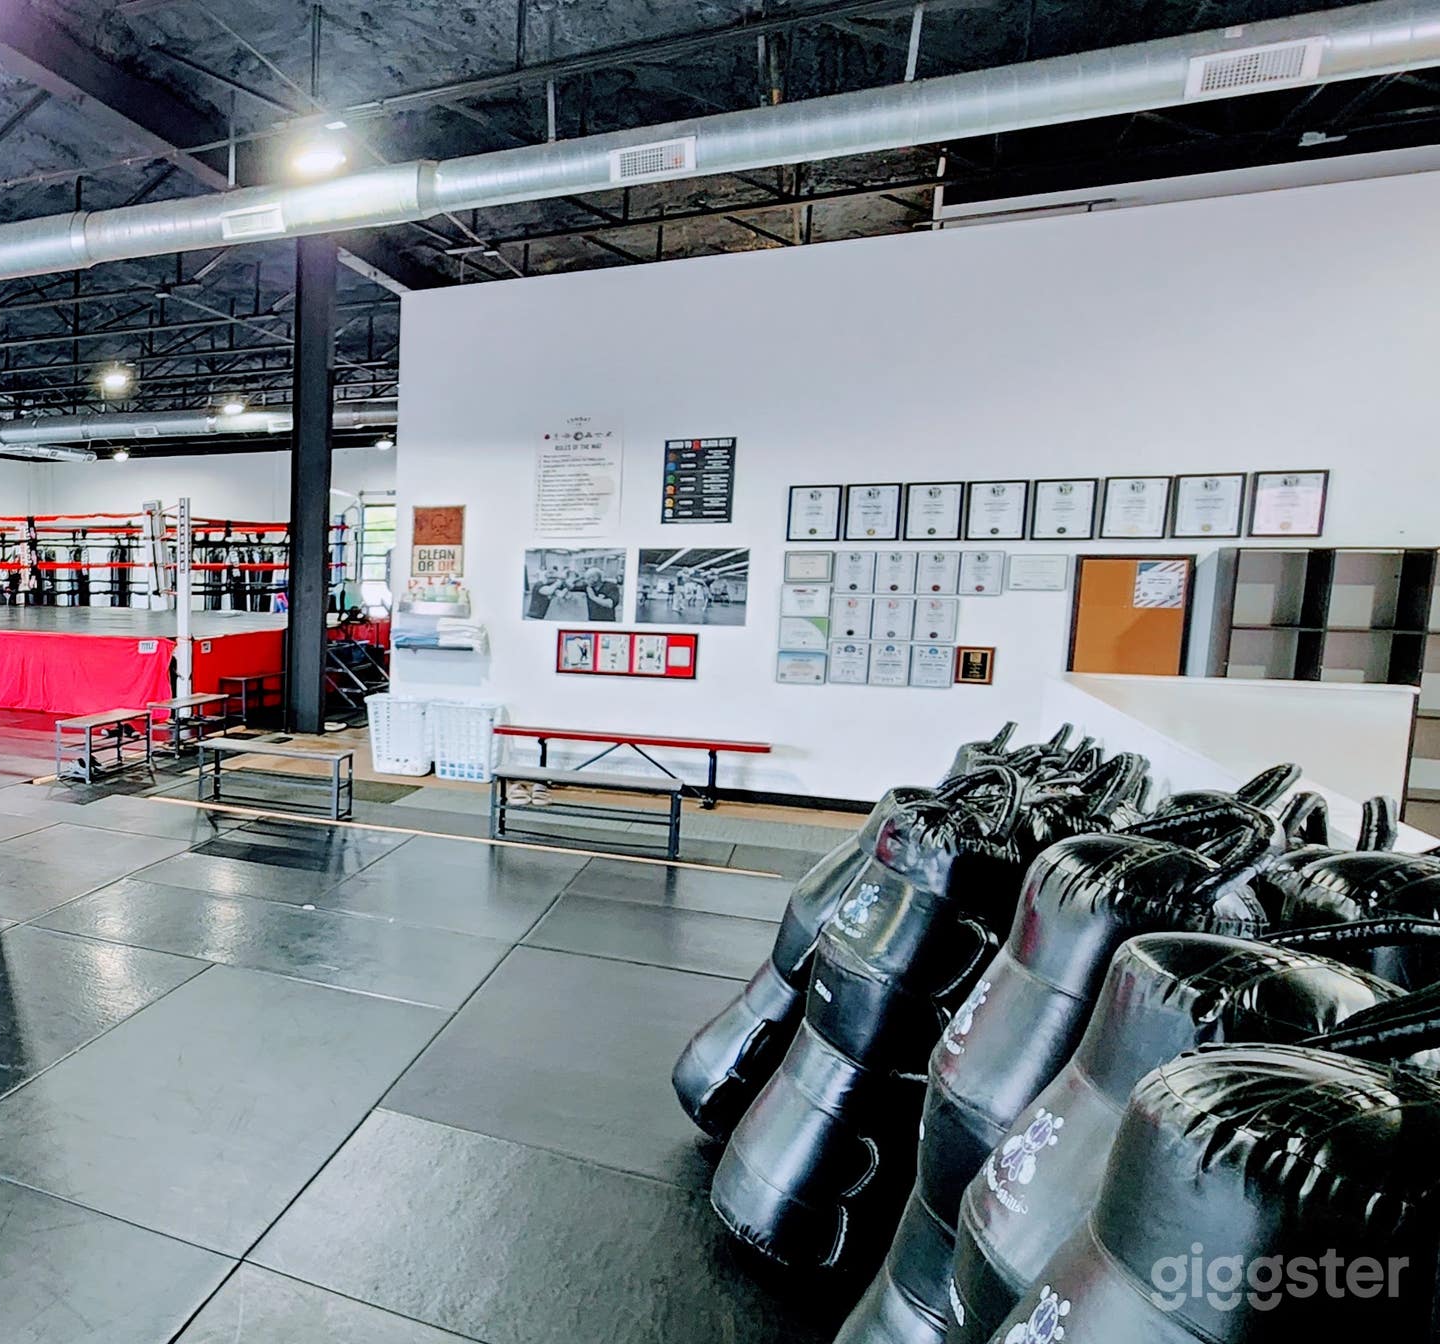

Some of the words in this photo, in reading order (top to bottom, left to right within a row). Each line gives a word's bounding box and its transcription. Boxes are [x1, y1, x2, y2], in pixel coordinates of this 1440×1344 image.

[418, 549, 455, 560] CLEAN
[418, 560, 434, 571] OR
[438, 560, 455, 571] DIE
